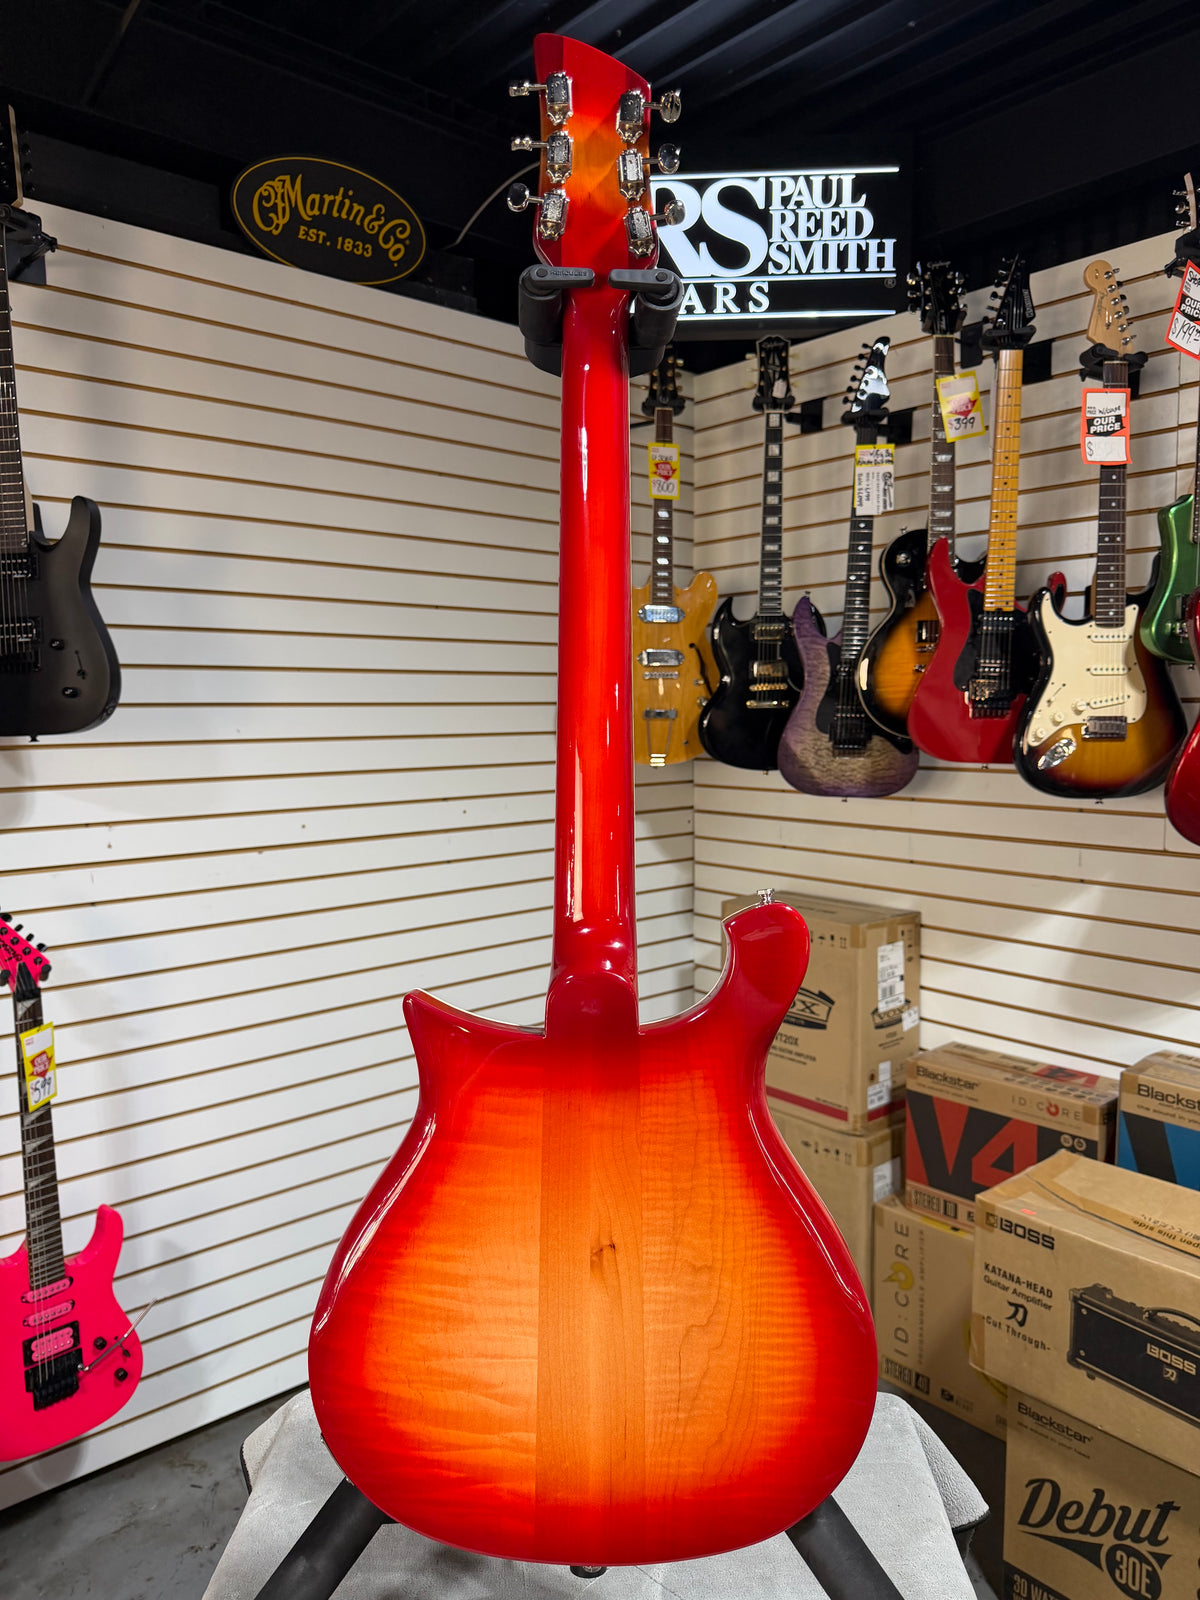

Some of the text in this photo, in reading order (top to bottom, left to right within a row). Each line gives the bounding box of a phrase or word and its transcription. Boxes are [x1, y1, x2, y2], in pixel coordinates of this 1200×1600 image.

[768, 174, 867, 209] PAUL
[298, 225, 374, 258] EST. 1833
[768, 207, 875, 242] REED
[767, 238, 897, 275] SMITH
[1090, 422, 1121, 434] PRICE
[1093, 416, 1116, 426] OUR
[916, 1066, 979, 1090] Blackstar
[1000, 1217, 1056, 1251] BOSS
[983, 1274, 1053, 1312] Guitar Amplifier
[984, 1261, 1054, 1299] KATANA-HEAD
[884, 1357, 913, 1386] STEREO
[1146, 1342, 1197, 1377] BOSS
[1017, 1402, 1091, 1444] Blackstar
[1018, 1478, 1182, 1547] Debut
[1013, 1573, 1028, 1598] 30
[1114, 1550, 1153, 1598] 30E
